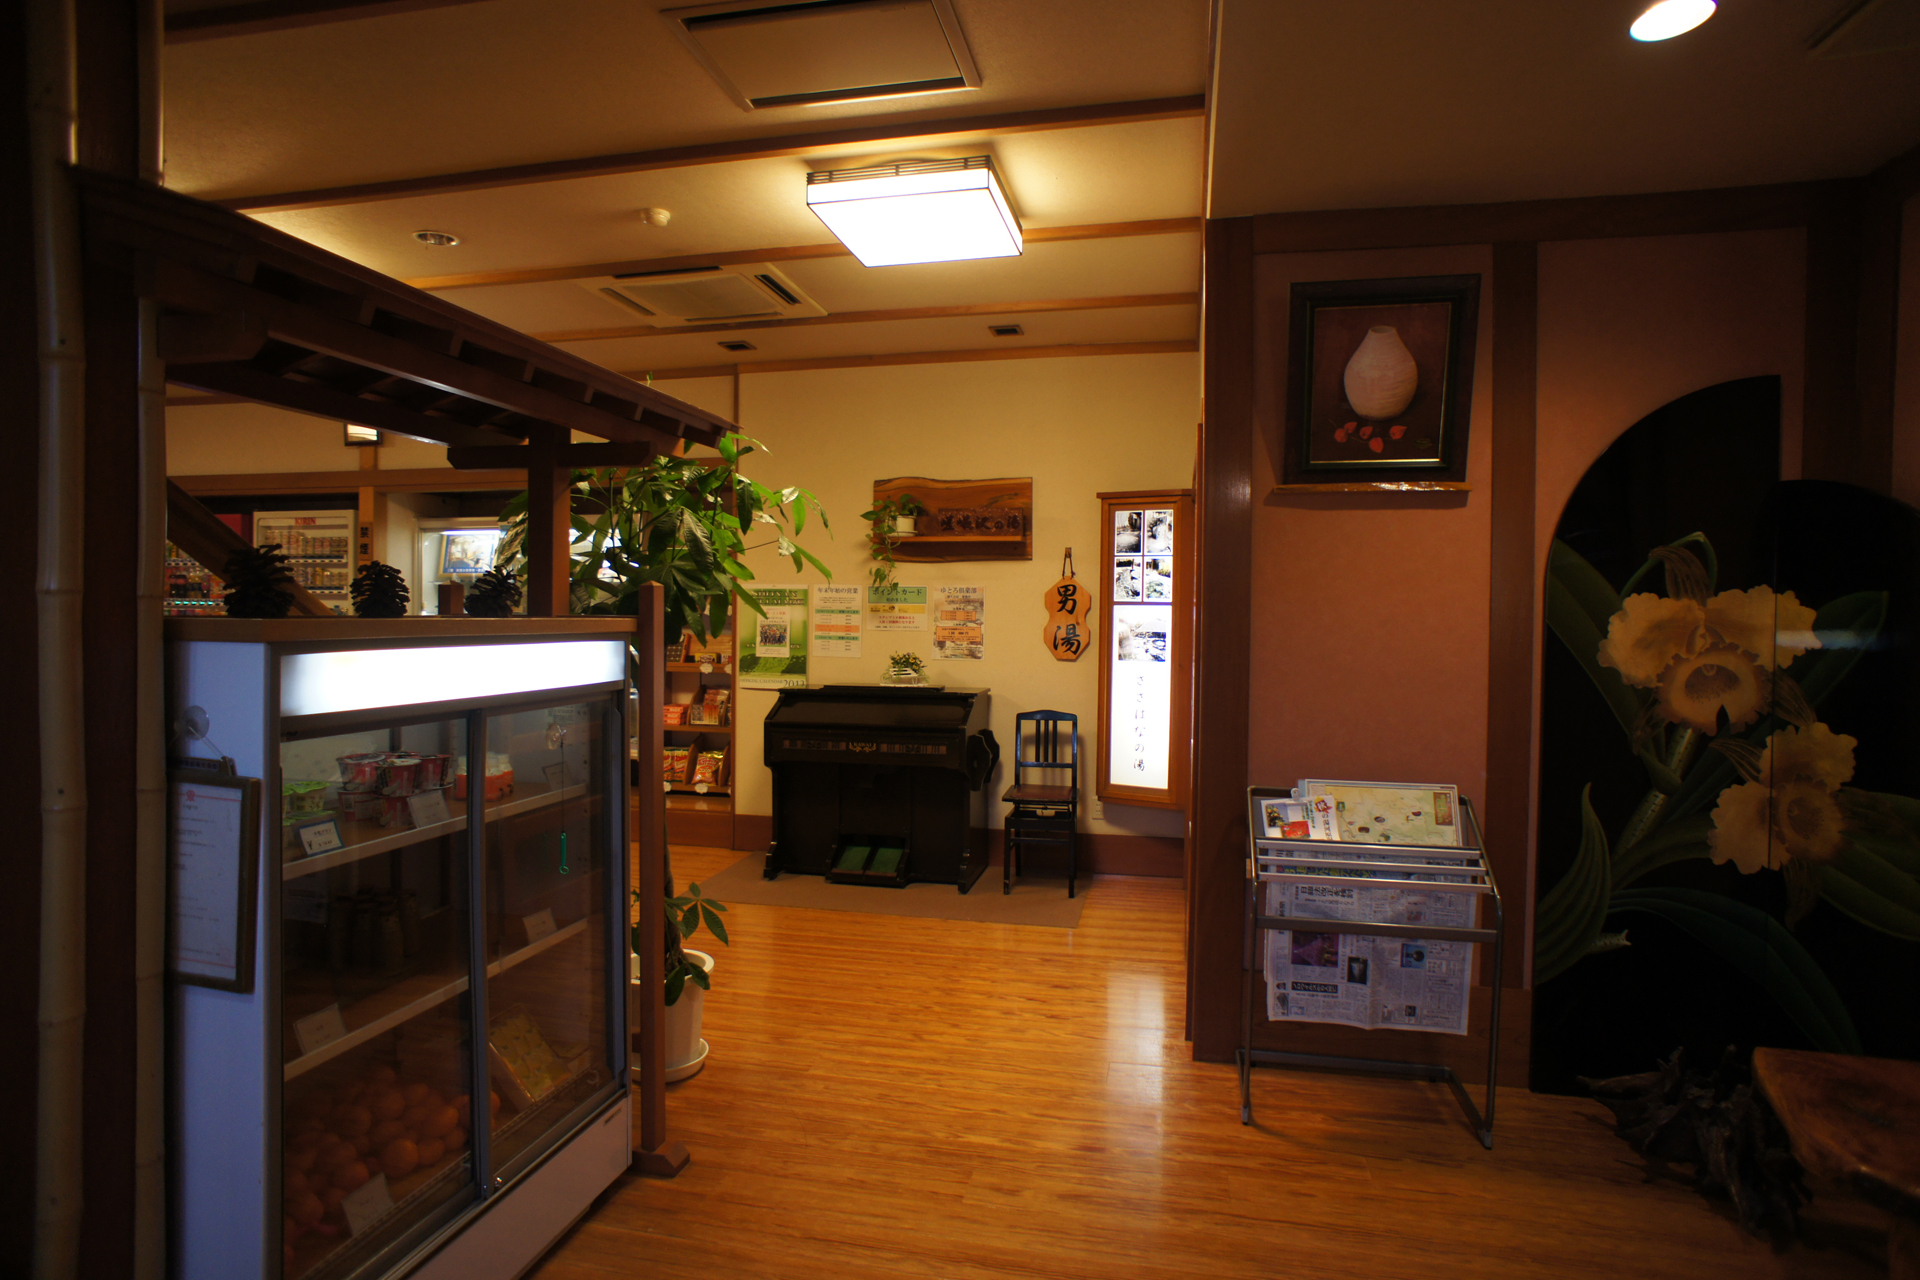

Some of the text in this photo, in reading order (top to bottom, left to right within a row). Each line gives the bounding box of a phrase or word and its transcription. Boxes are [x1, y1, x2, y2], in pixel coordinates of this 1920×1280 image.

[295, 517, 317, 525] KIRIN
[817, 587, 859, 595] 年末年始の営業
[1053, 583, 1082, 656] 男湯
[784, 678, 806, 688] 2013
